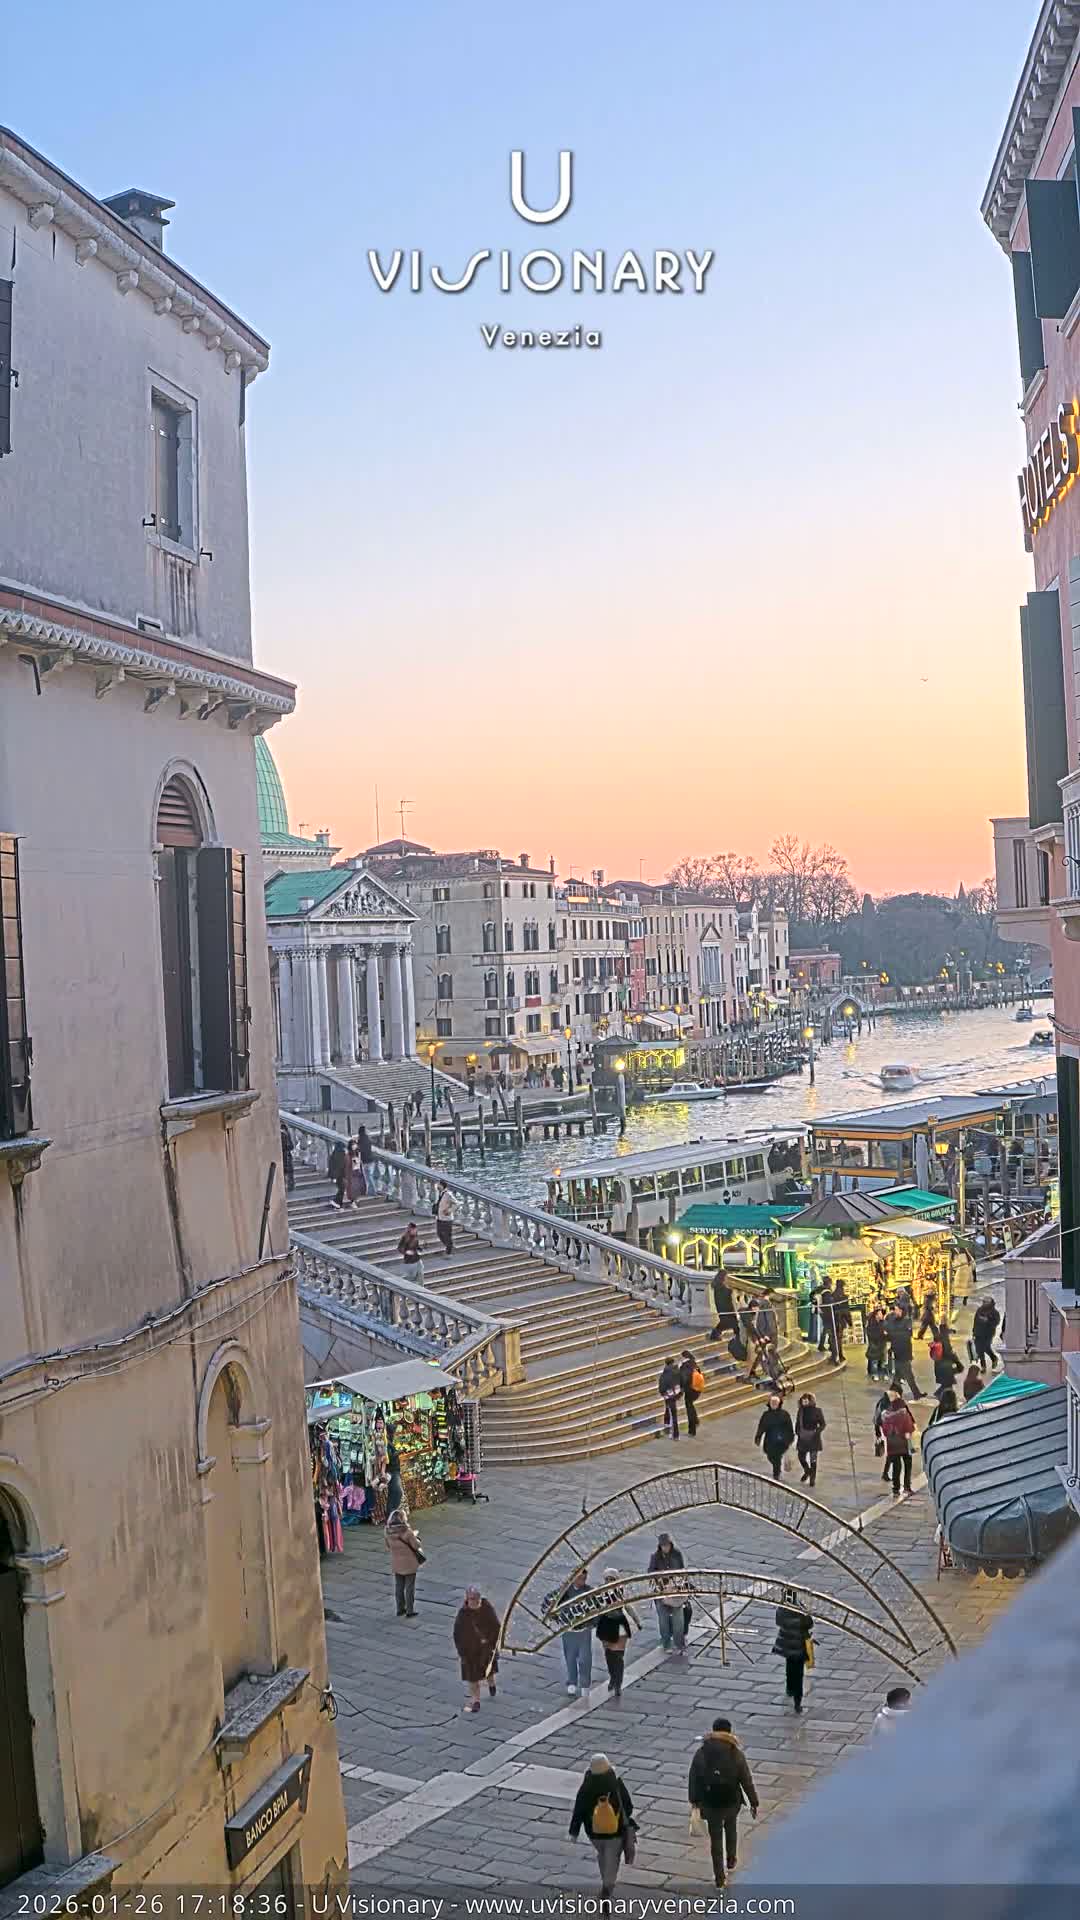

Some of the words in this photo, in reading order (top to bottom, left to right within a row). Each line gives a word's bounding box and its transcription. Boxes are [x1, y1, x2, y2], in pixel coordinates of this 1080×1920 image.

[689, 1226, 728, 1235] SERVIZIO
[245, 1808, 273, 1849] BANCO
[272, 1790, 289, 1819] BPM
